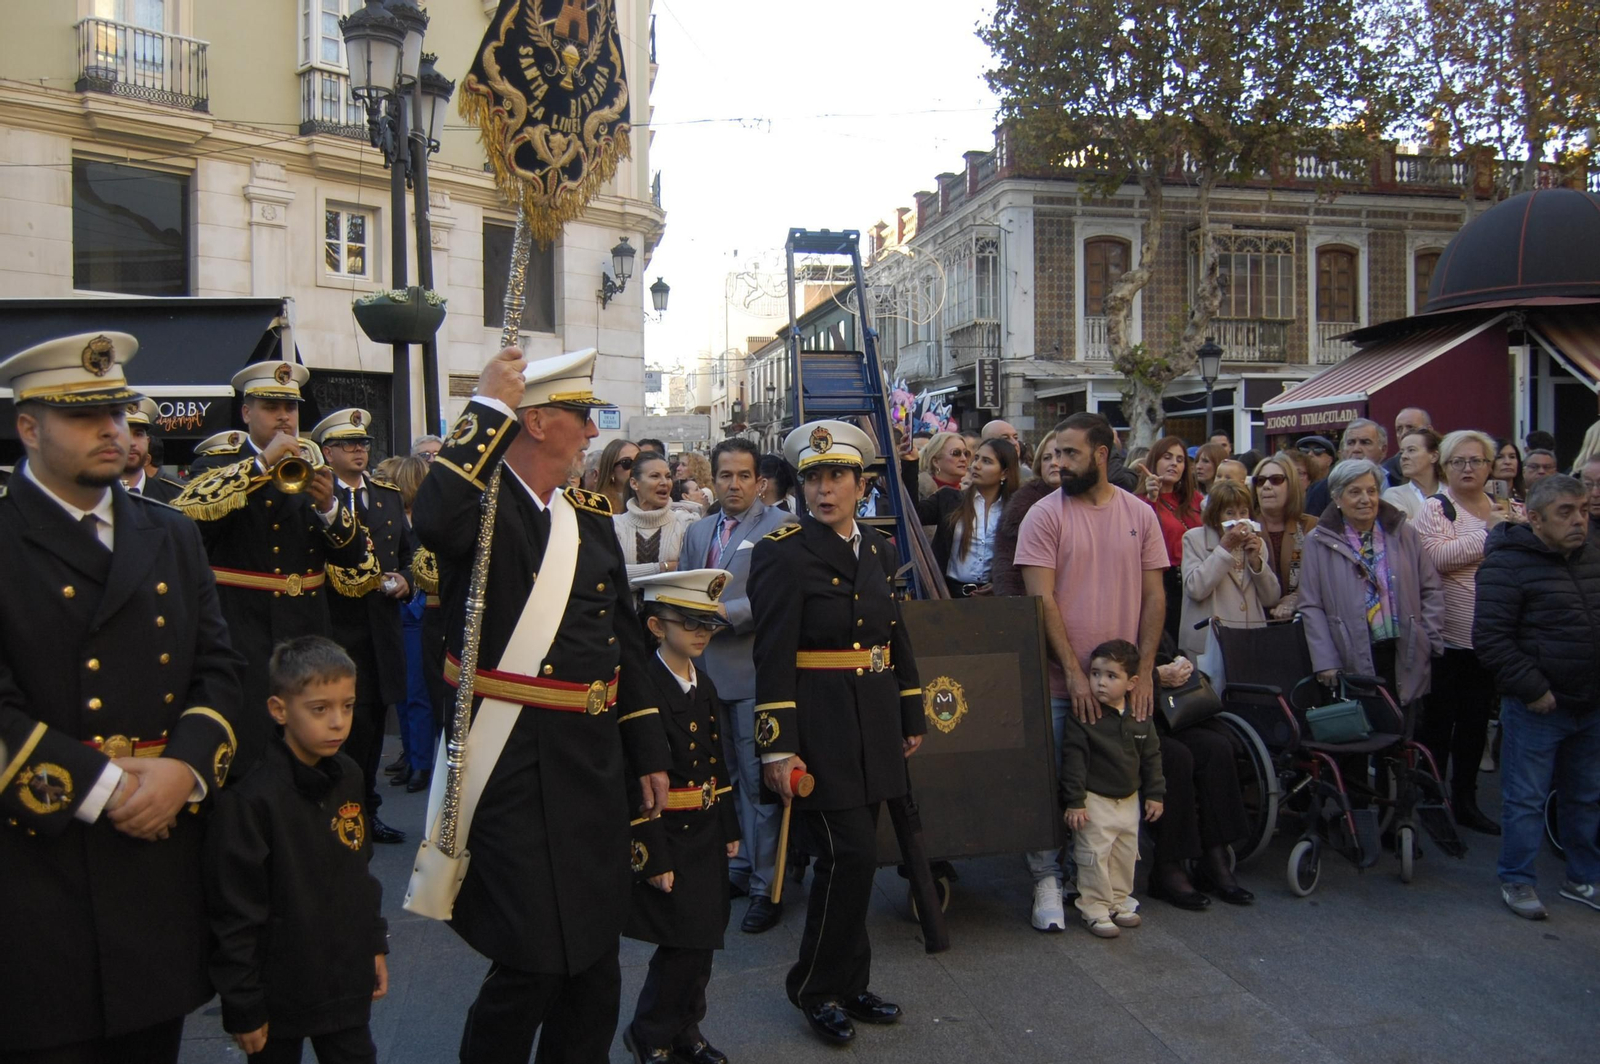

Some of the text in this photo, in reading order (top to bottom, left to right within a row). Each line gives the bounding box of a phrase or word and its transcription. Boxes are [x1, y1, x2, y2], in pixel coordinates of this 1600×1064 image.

[519, 45, 549, 101] SANTA
[527, 100, 545, 120] LA
[157, 401, 212, 417] OBBY
[1267, 408, 1358, 429] KIOSCO INMACULADA
